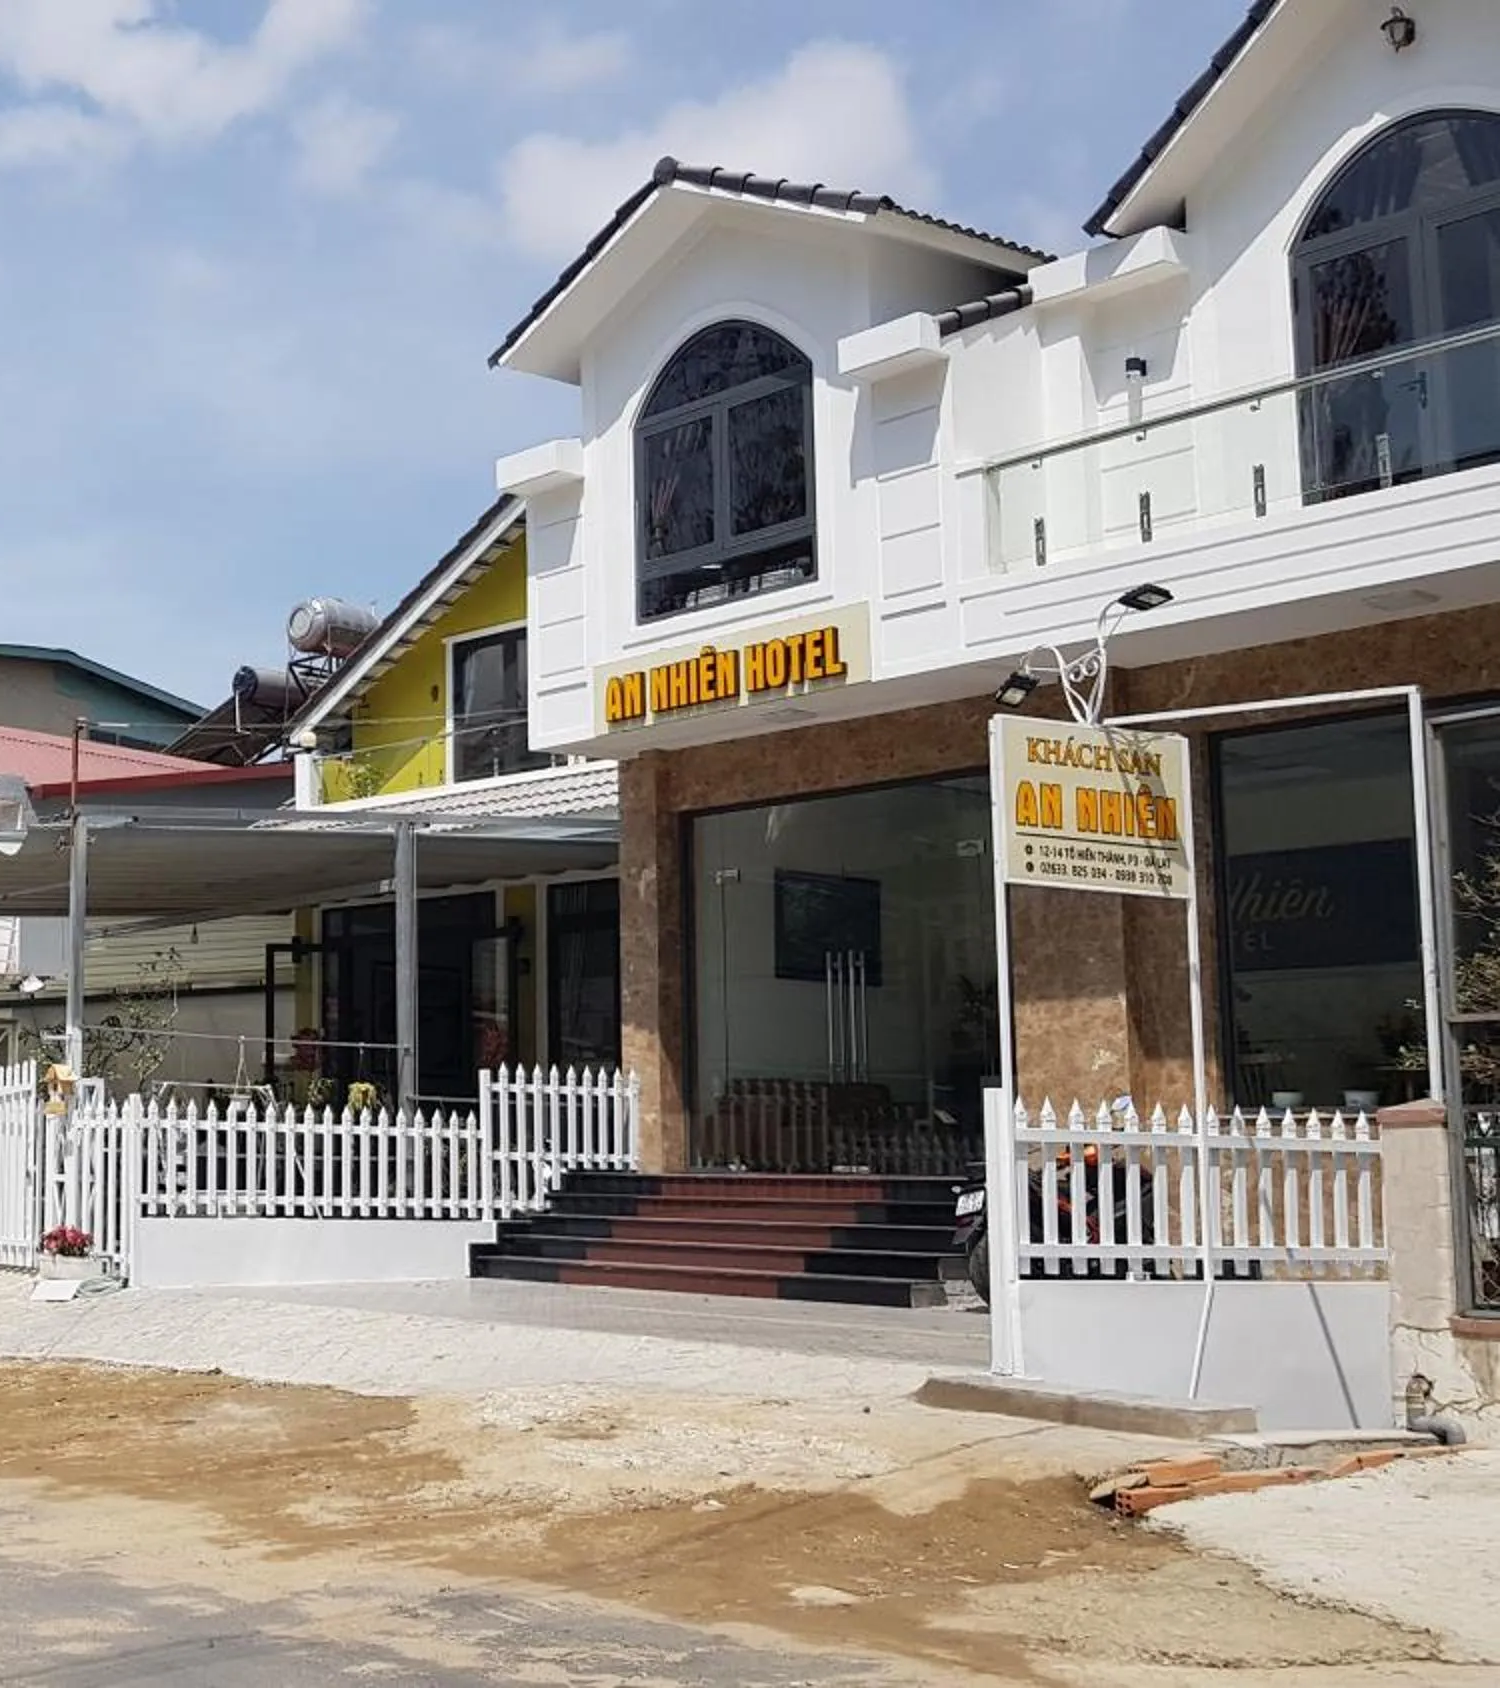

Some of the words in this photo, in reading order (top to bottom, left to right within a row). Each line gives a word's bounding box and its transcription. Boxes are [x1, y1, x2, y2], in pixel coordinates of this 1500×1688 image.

[605, 672, 645, 722] AN
[651, 645, 739, 712] NHIÊN
[744, 625, 847, 692] HOTEL
[1026, 735, 1113, 772] KHÁCH
[1015, 779, 1063, 829] AN
[1076, 783, 1177, 841] NHIÊN
